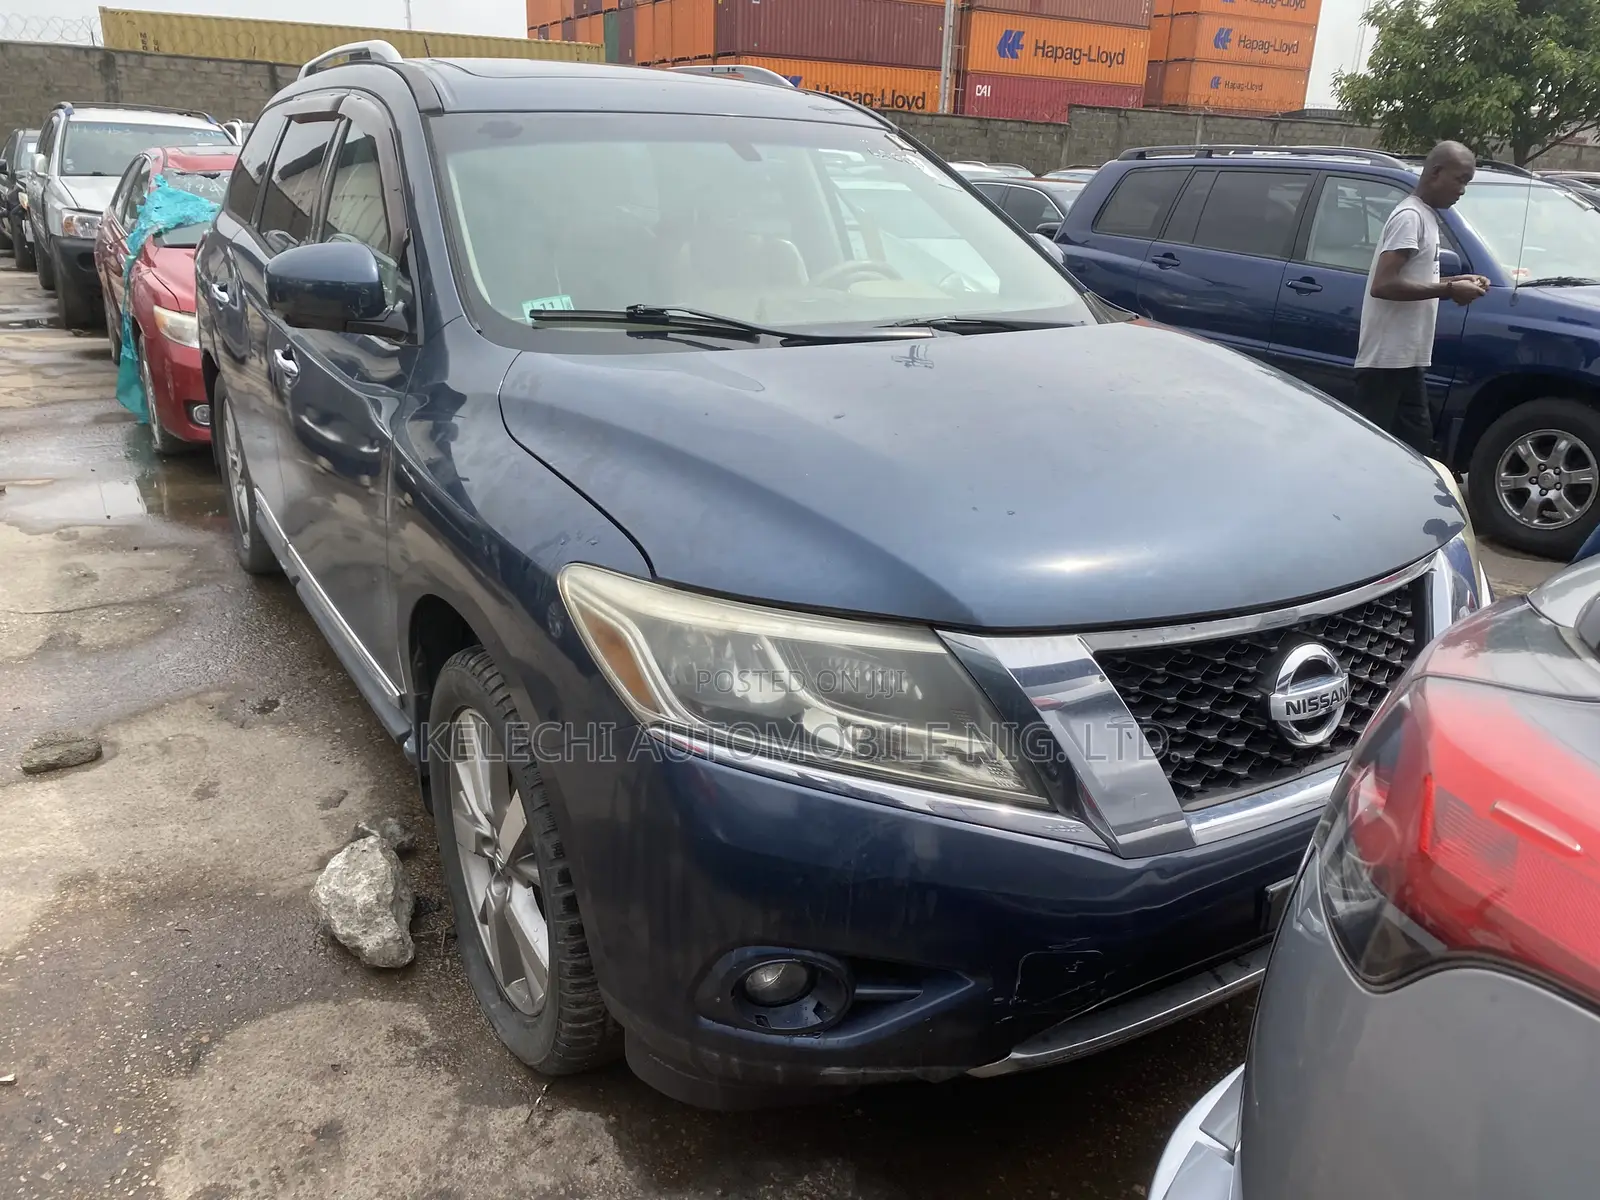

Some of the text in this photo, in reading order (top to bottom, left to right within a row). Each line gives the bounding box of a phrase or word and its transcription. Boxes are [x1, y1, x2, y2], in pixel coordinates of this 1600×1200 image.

[1033, 38, 1126, 68] Hapag-Lloyd
[1238, 34, 1299, 56] Hapag-Lloyd
[975, 84, 991, 97] CAI
[1224, 80, 1263, 92] Hapag-Lloyd
[1285, 685, 1348, 716] NISSAN
